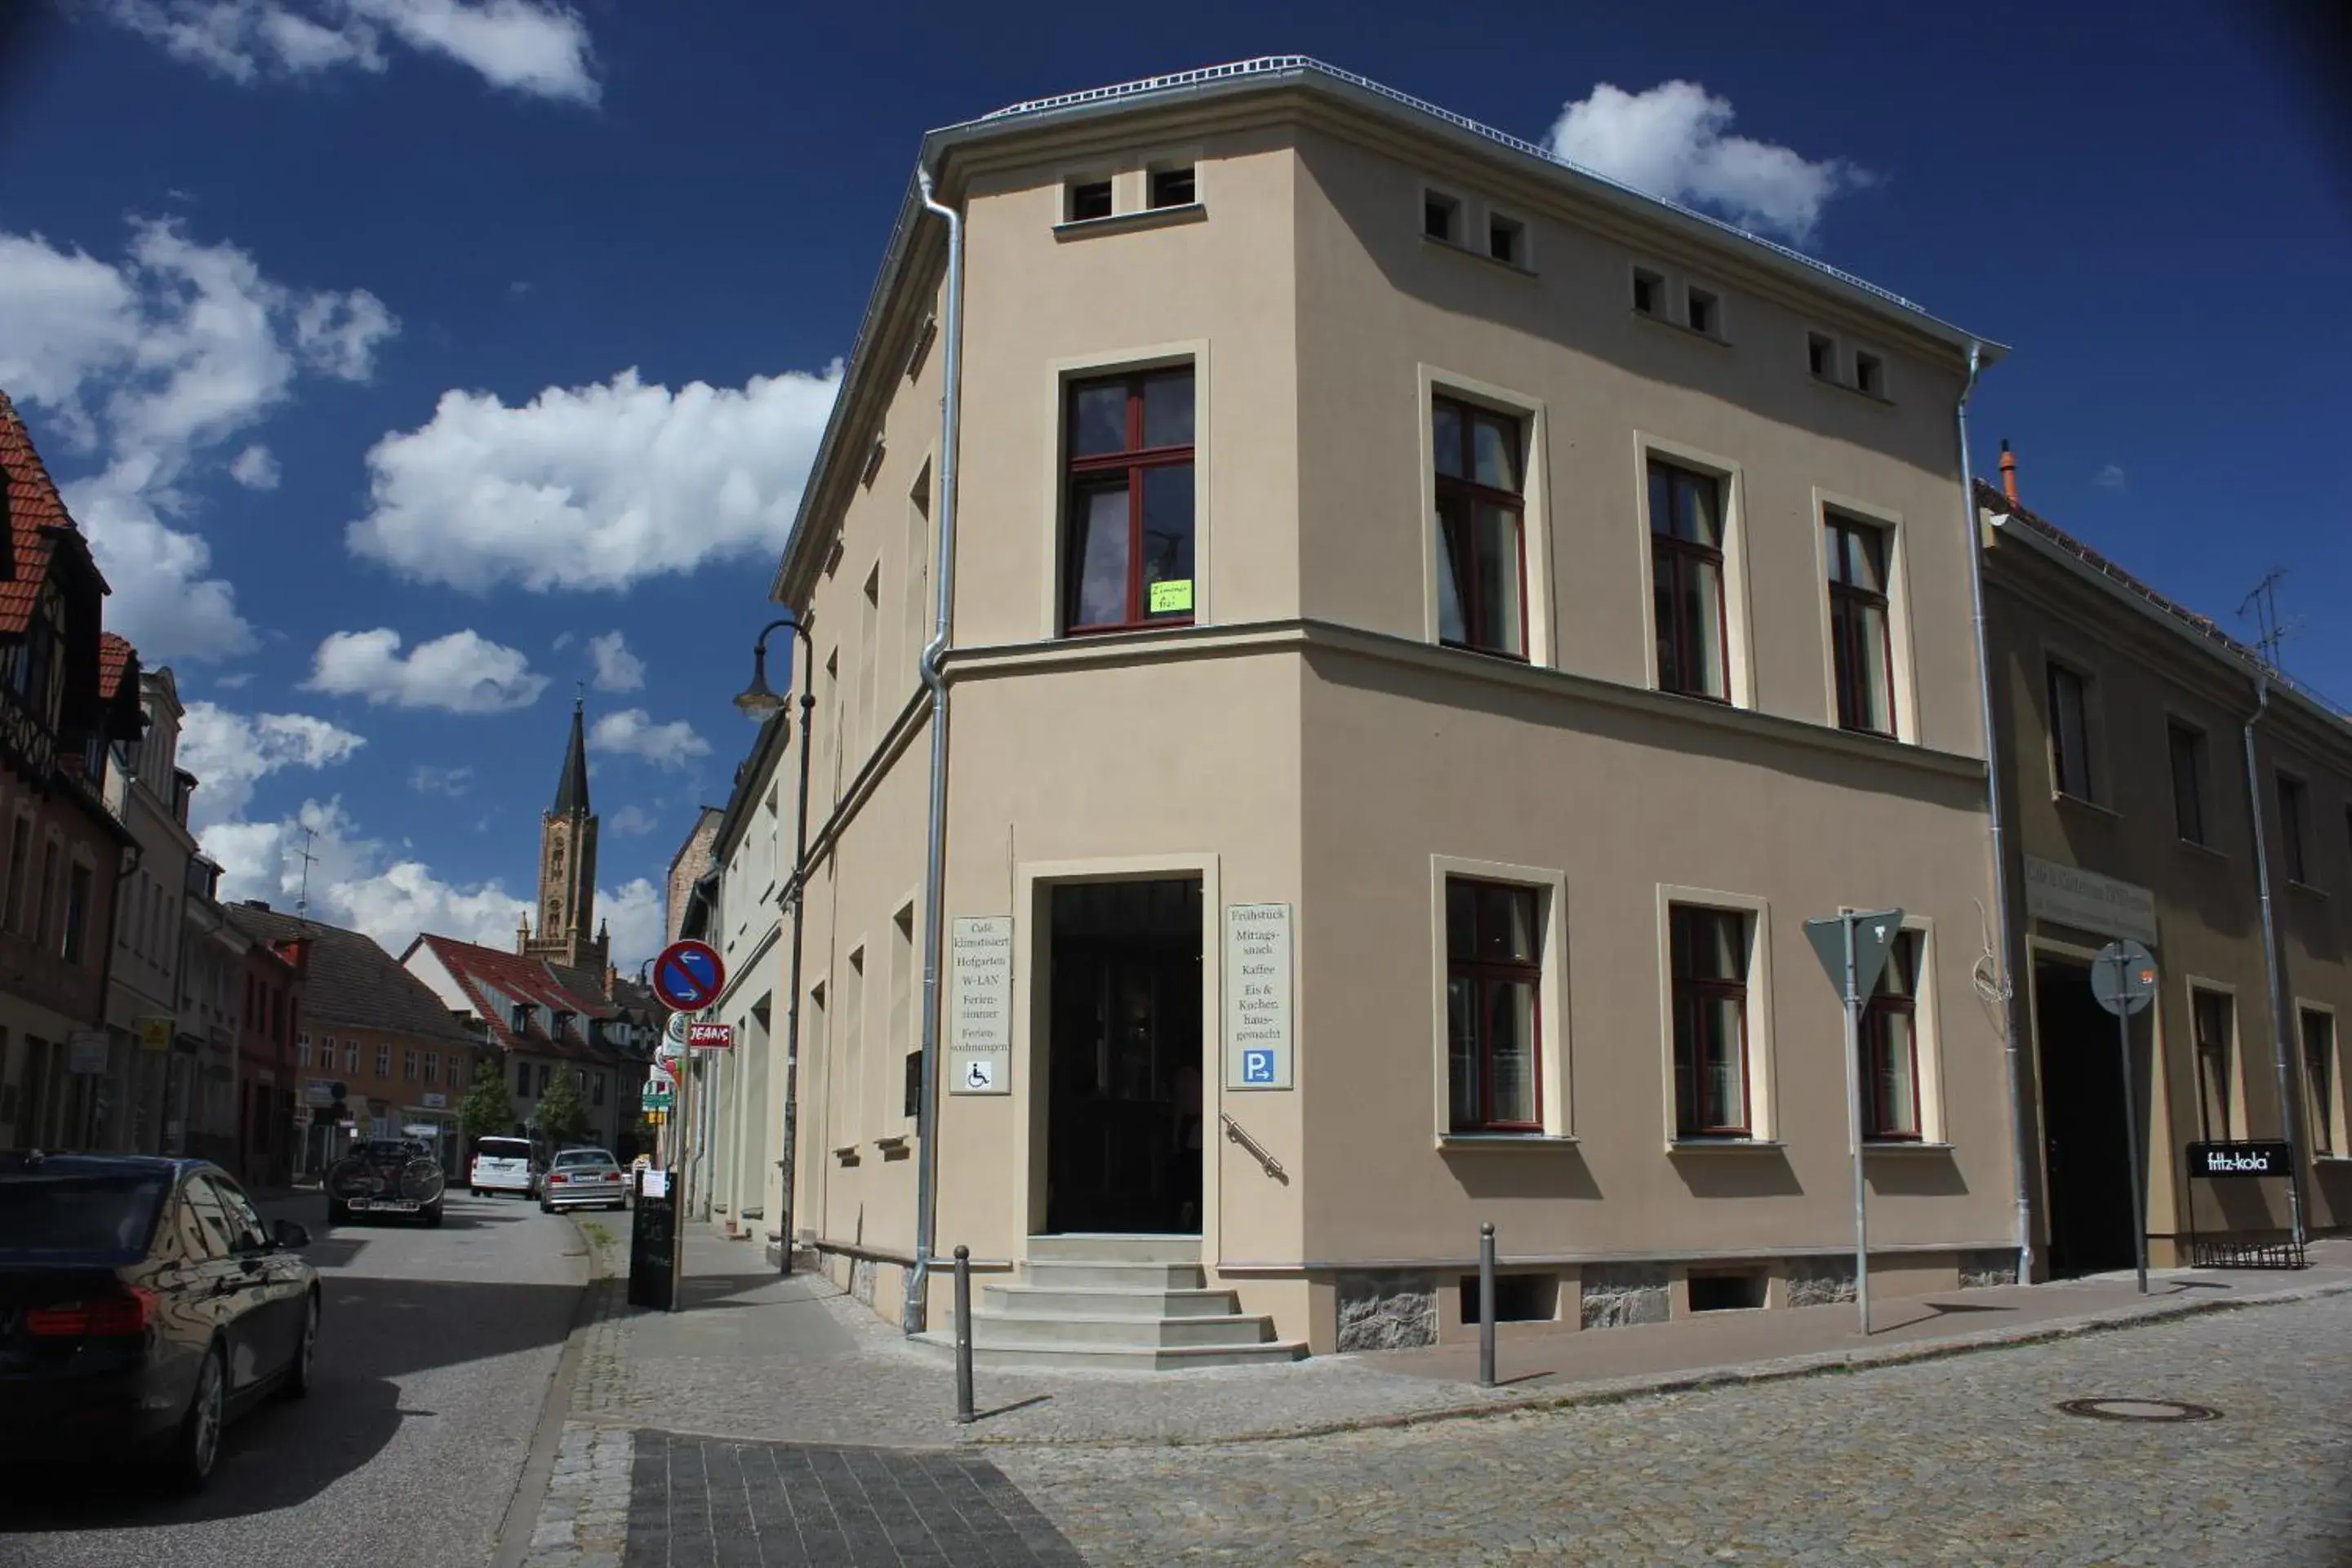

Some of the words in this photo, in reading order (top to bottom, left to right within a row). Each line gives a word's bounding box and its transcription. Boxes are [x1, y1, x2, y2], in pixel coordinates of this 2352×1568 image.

[1231, 909, 1285, 922] Frühstück
[971, 922, 994, 934] Café
[1236, 931, 1280, 942] Mittags-
[954, 938, 1009, 948] klimatisiert
[1243, 945, 1273, 955] snack
[957, 955, 1006, 968] Hofgarten
[1242, 965, 1275, 975] Kaffee
[963, 975, 1000, 986] W-LAN
[1245, 984, 1261, 996] Eis
[1263, 984, 1272, 995] &
[690, 1025, 729, 1042] JEANS
[1236, 1029, 1281, 1042] gemacht
[1247, 1053, 1266, 1080] P
[2207, 1151, 2268, 1170] fritz-kola
